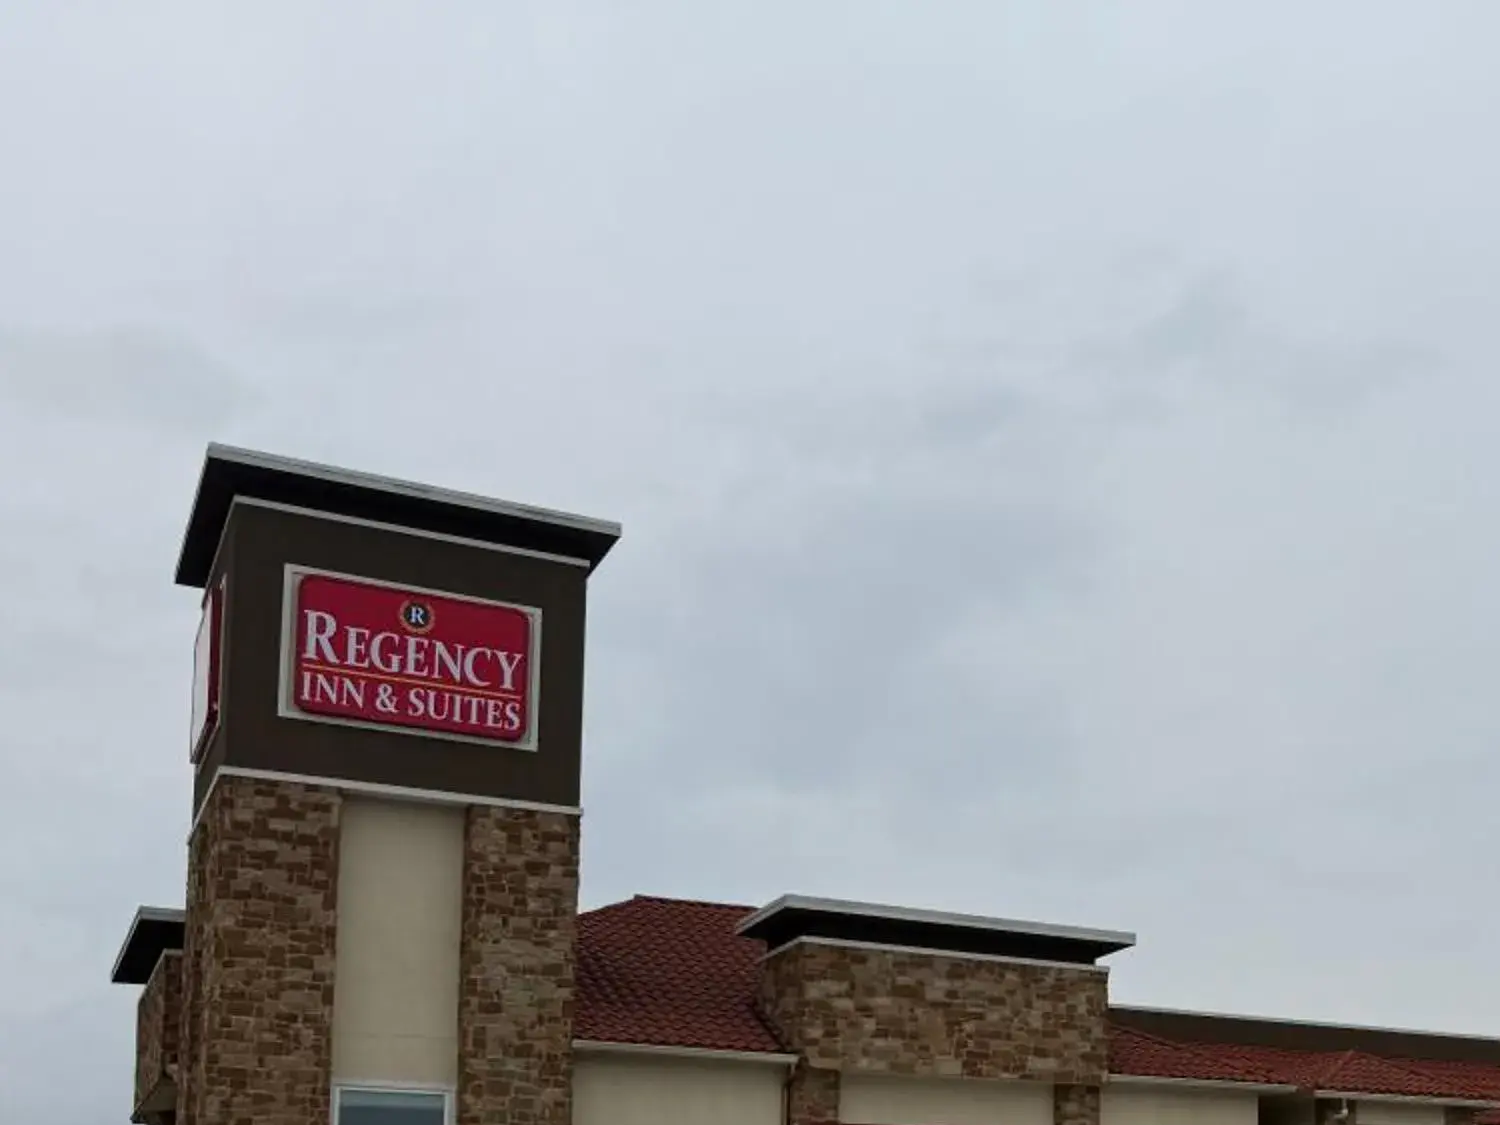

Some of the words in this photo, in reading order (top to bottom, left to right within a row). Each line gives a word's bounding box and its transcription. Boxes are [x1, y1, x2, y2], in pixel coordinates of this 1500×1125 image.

[409, 606, 424, 625] R
[303, 609, 523, 690] REGENCY
[301, 671, 366, 709] INN
[375, 683, 398, 713] &
[408, 687, 520, 731] SUITES
